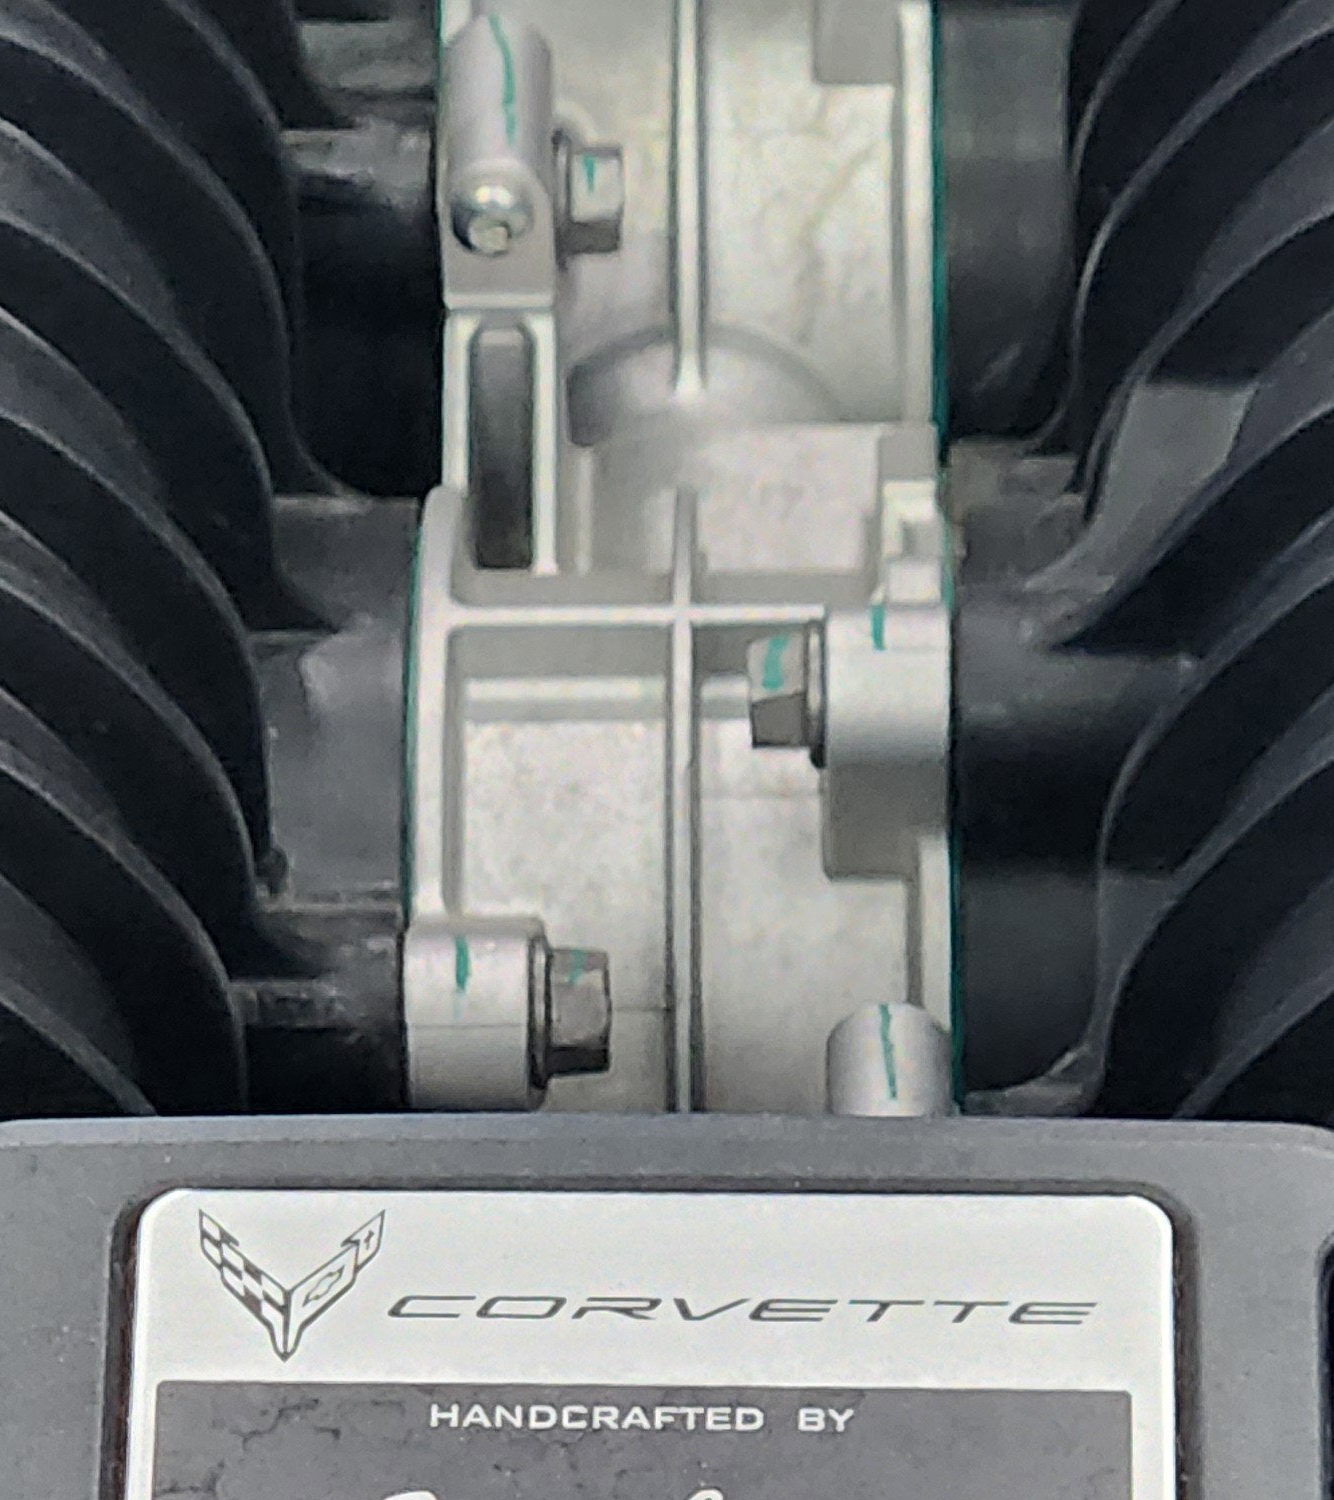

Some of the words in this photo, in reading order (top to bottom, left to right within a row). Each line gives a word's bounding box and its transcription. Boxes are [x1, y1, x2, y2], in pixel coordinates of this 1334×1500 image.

[388, 1296, 1097, 1325] CORVETTE
[429, 1403, 765, 1432] HANDCRAFTED
[797, 1407, 855, 1433] BY
